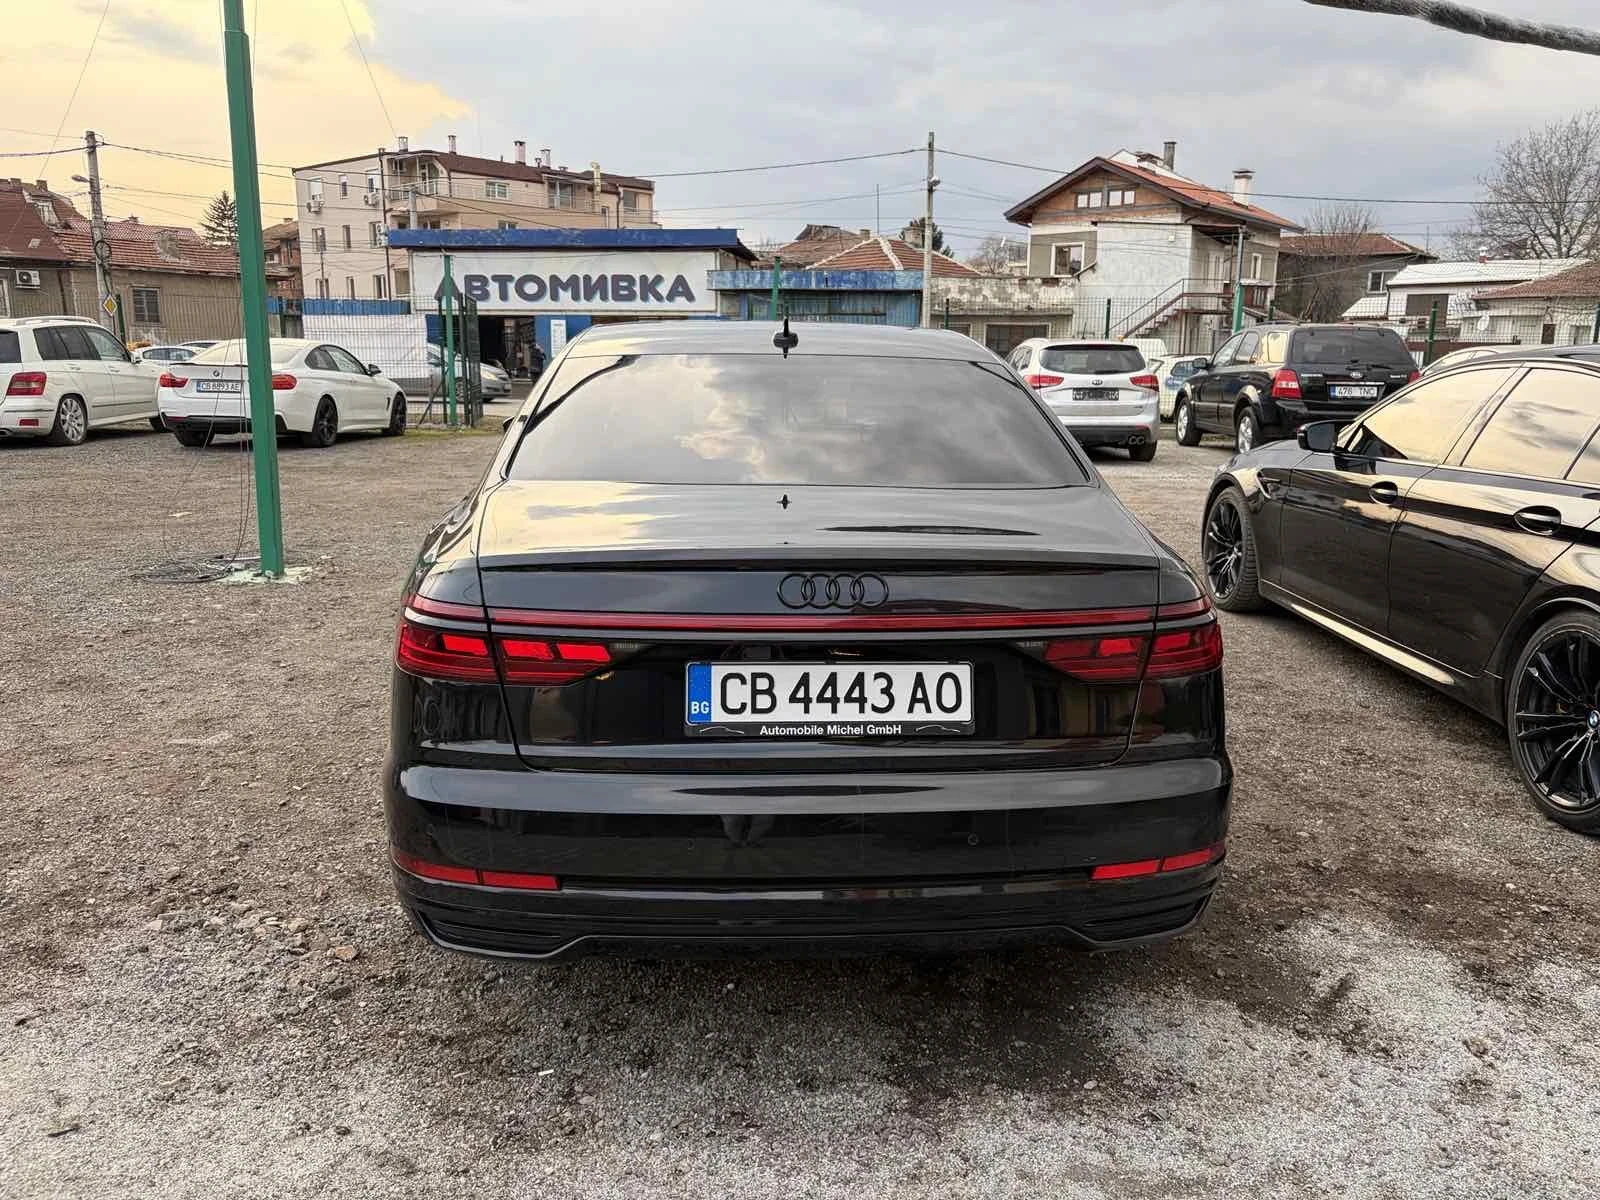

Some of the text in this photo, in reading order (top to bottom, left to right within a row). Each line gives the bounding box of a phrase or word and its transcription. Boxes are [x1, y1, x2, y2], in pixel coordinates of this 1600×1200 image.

[720, 671, 962, 714] CB 4443 AO
[691, 701, 710, 714] BG
[759, 724, 902, 736] Automobile Michel GmbH
